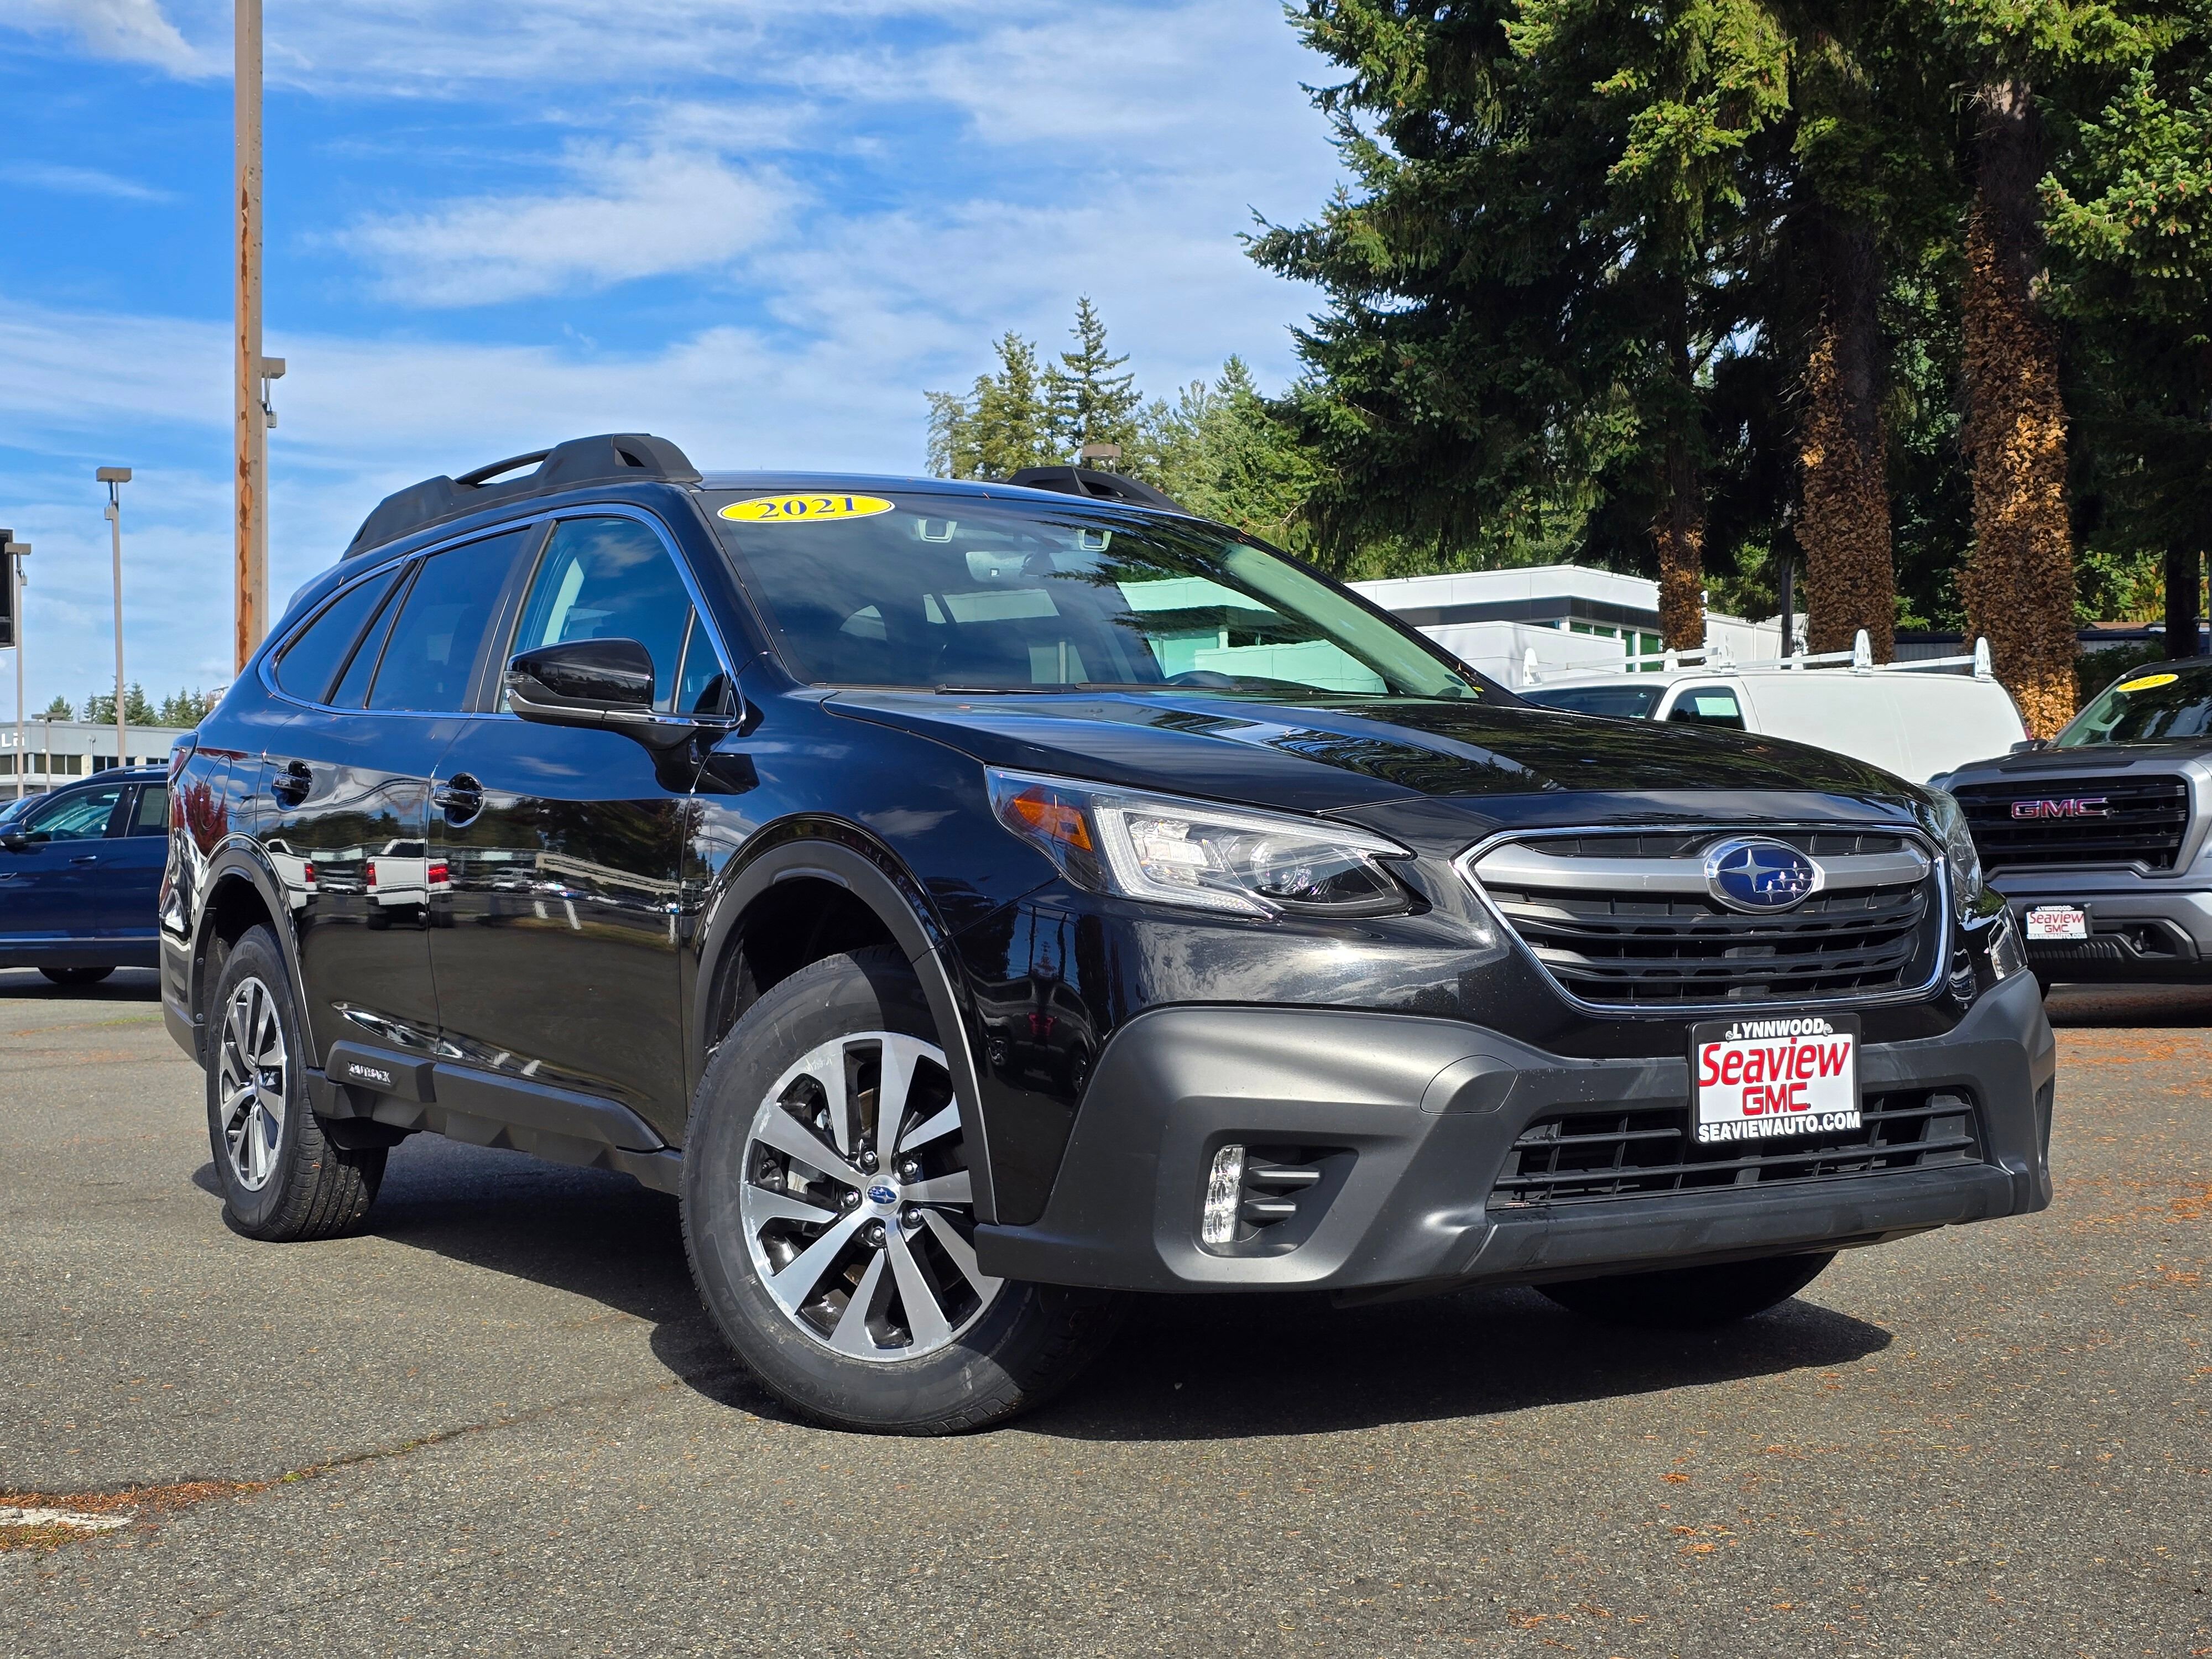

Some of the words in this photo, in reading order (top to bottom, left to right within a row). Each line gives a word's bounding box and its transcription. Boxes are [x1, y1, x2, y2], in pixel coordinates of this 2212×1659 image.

[755, 497, 859, 519] 2021
[2011, 797, 2109, 818] GMC
[2029, 911, 2084, 924] Seaview
[2044, 924, 2069, 932] GMC
[1733, 1018, 1824, 1039] LYNNWOOD
[1699, 1037, 1850, 1087] Seaview
[1743, 1082, 1808, 1116] GMC
[1699, 1112, 1861, 1142] SEAVIEWAUTO.COM
